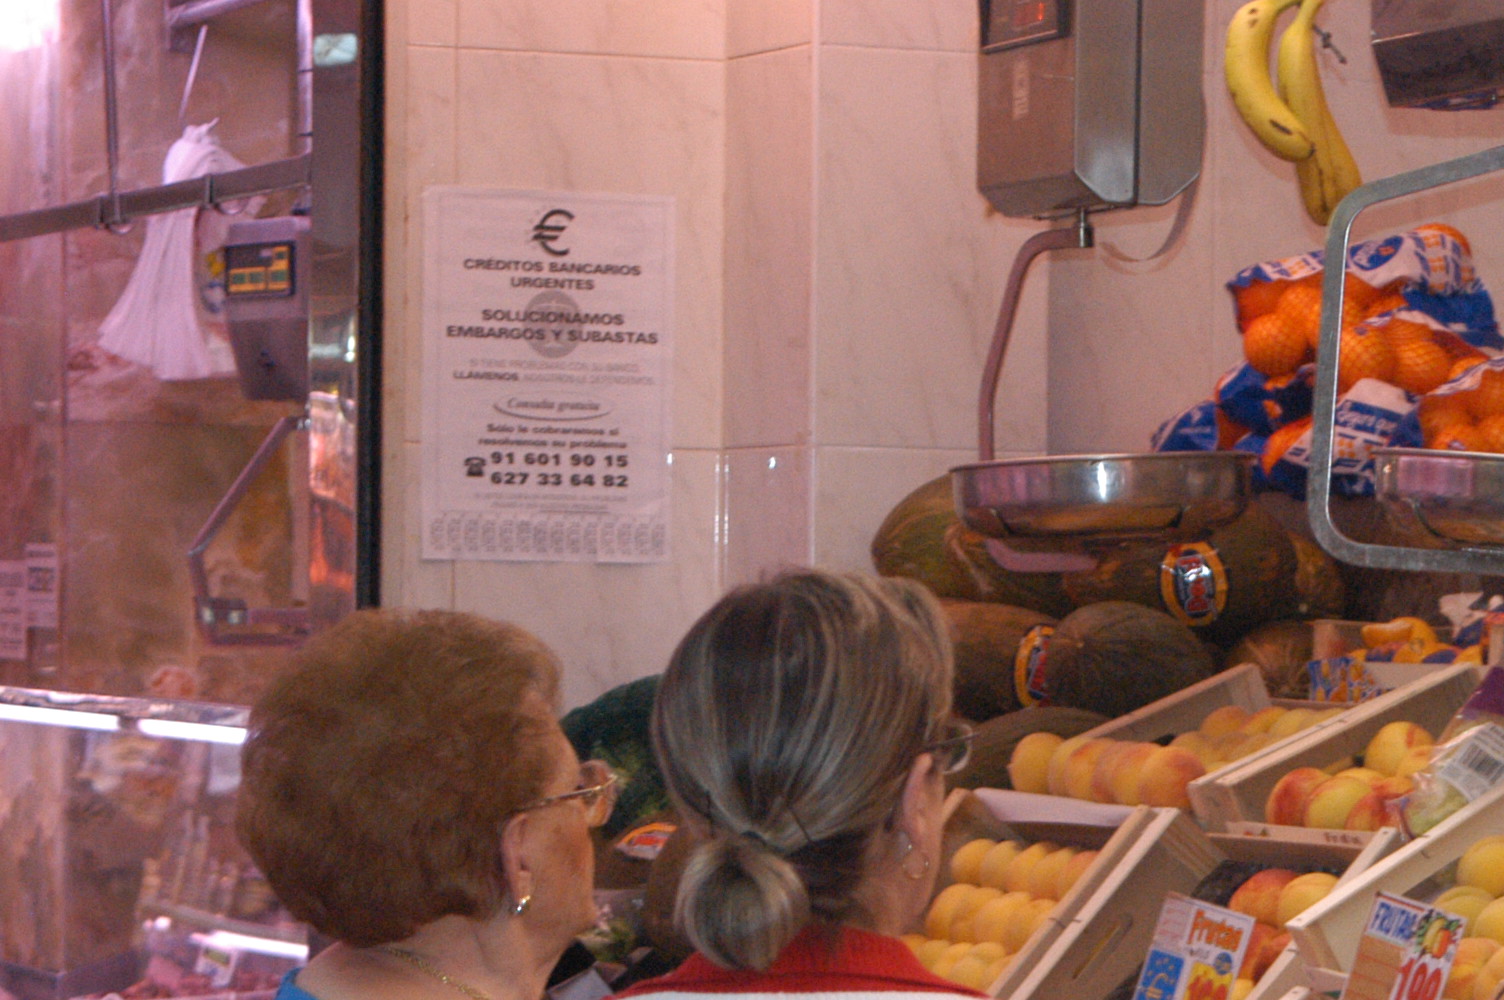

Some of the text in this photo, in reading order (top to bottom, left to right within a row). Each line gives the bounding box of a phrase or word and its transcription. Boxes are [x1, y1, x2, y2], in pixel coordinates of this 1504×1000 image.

[464, 257, 641, 276] CRÉDITOS BANCARIOS
[510, 276, 595, 290] URGENTES
[482, 309, 625, 325] SOLUCIONAMOS
[446, 325, 659, 344] EMBARGOS Y SUBASTAS
[490, 451, 629, 468] 91 601 90 15
[490, 471, 629, 488] 627 33 64 82
[1186, 908, 1246, 954] Frutas
